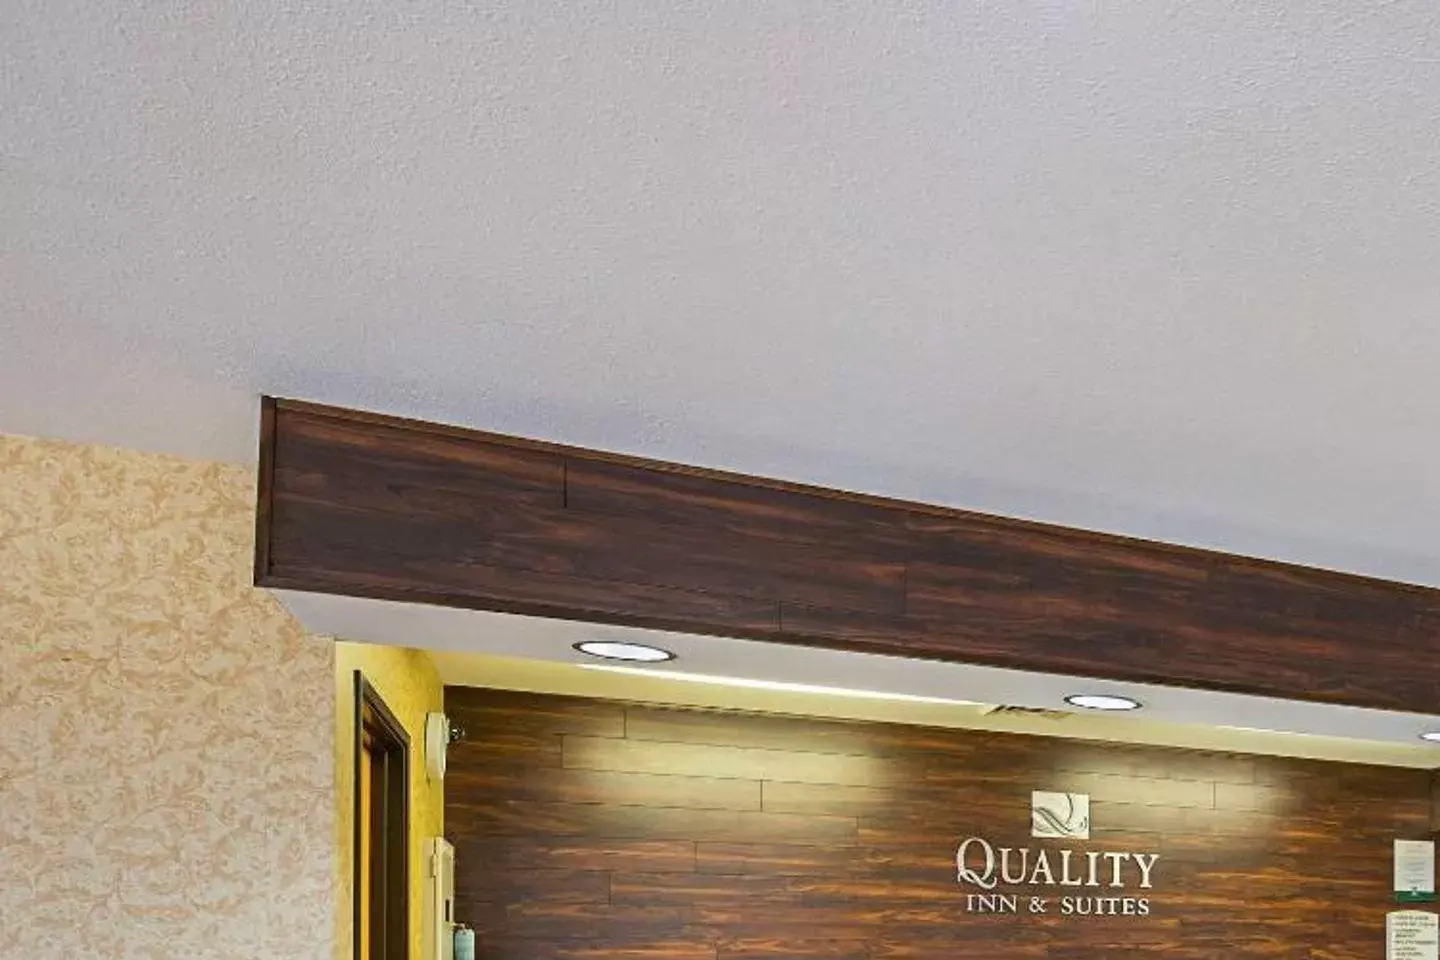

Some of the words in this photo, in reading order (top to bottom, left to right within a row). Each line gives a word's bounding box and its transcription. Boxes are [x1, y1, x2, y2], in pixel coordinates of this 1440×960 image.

[956, 836, 1160, 889] QUALITY
[966, 894, 1017, 914] INN
[1028, 896, 1048, 914] &
[1060, 896, 1150, 916] SUITES
